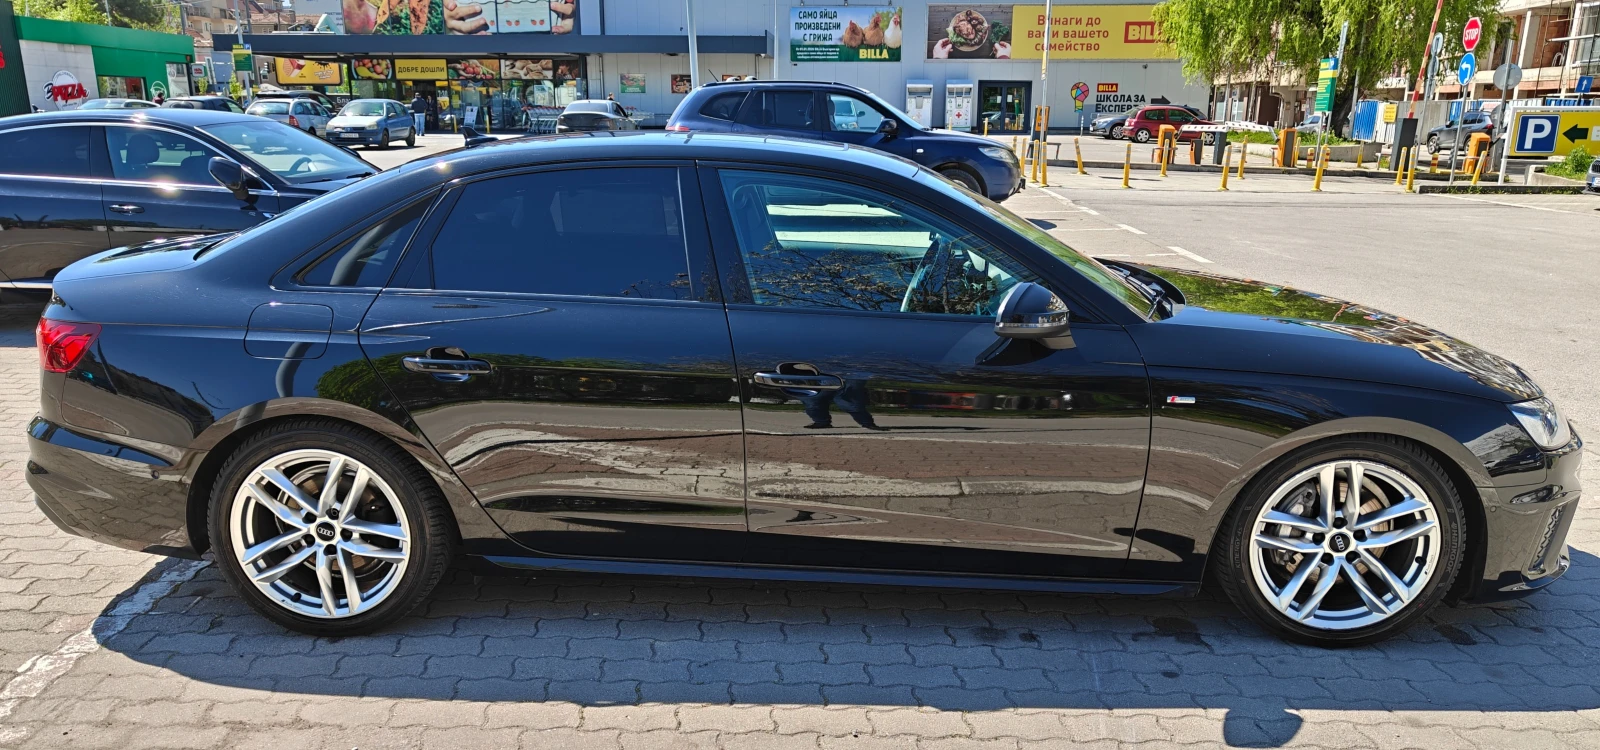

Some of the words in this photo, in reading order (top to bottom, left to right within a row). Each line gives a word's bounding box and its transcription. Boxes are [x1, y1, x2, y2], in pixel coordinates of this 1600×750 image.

[798, 10, 818, 19] САМО
[818, 8, 838, 20] ЯЙЦА
[794, 22, 841, 31] ПРОИЗВЕДЕНИ
[1085, 16, 1101, 27] до
[802, 33, 808, 42] С
[808, 33, 833, 42] ГРИЖА
[1051, 30, 1059, 39] и
[1063, 29, 1109, 39] вашето
[1464, 28, 1479, 41] STOP
[859, 48, 889, 59] BILLA
[397, 66, 419, 74] ДОБРЕ
[420, 66, 445, 74] ДОШЛИ
[52, 82, 87, 102] PIZZA
[1098, 84, 1117, 92] BILLA
[1095, 94, 1132, 103] ШКОЛА
[1133, 94, 1146, 103] ЗА
[1095, 102, 1140, 113] ЕКСПЕР
[1523, 118, 1552, 150] P
